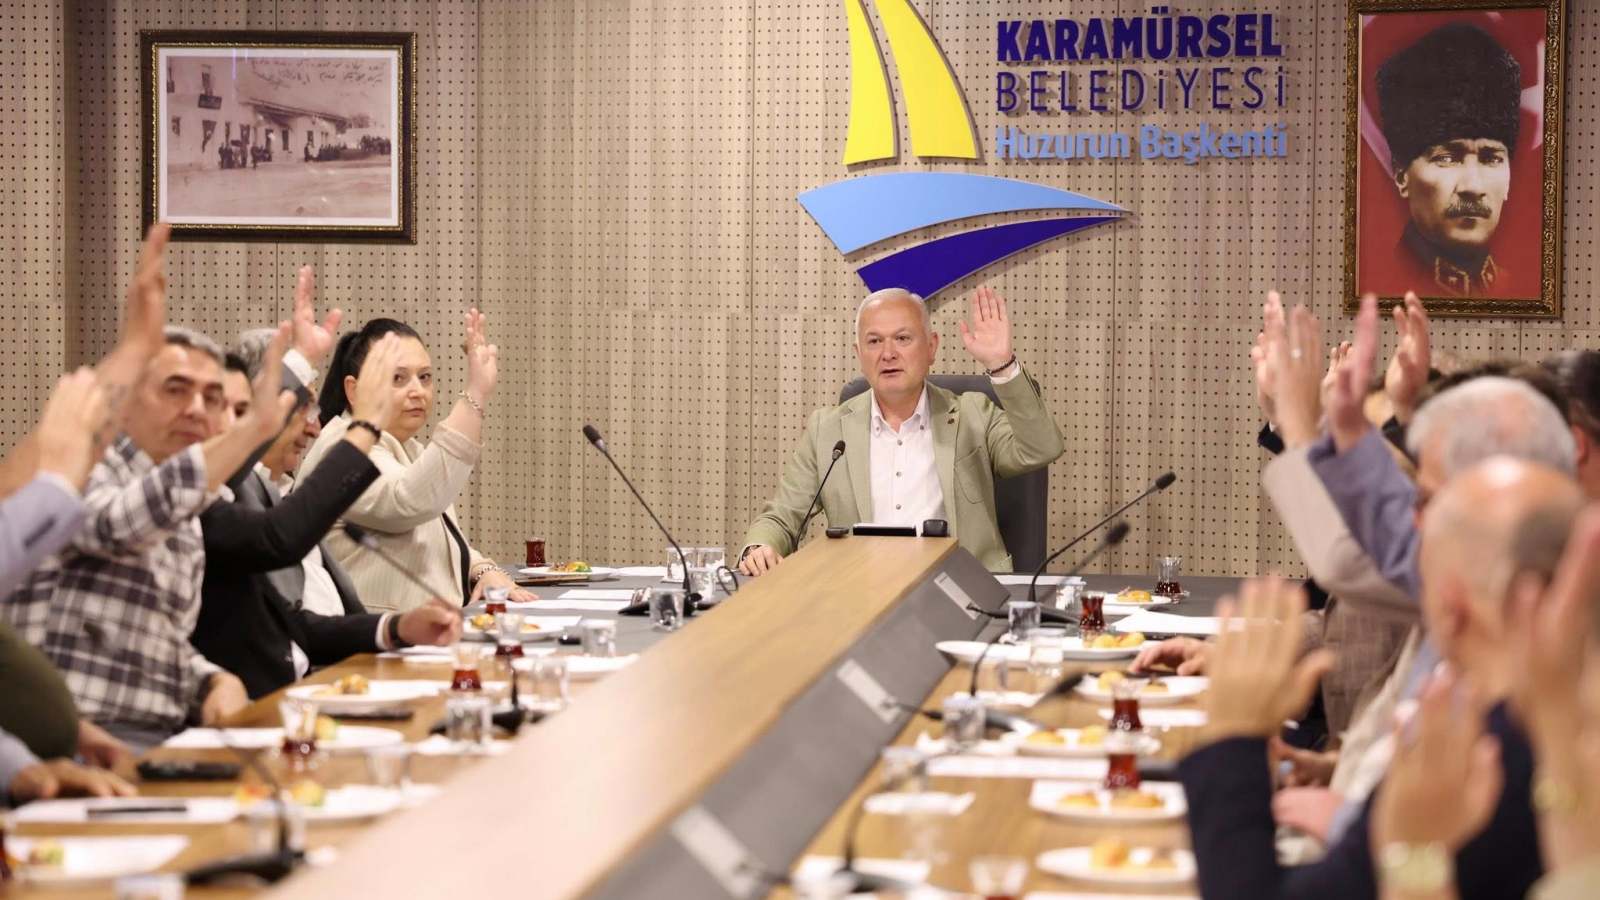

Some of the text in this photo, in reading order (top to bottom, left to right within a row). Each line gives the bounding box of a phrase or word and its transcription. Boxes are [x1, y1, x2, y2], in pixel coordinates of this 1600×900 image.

[997, 6, 1282, 61] KARAMÜRSEL
[996, 122, 1288, 165] Huzurun Başkenti
